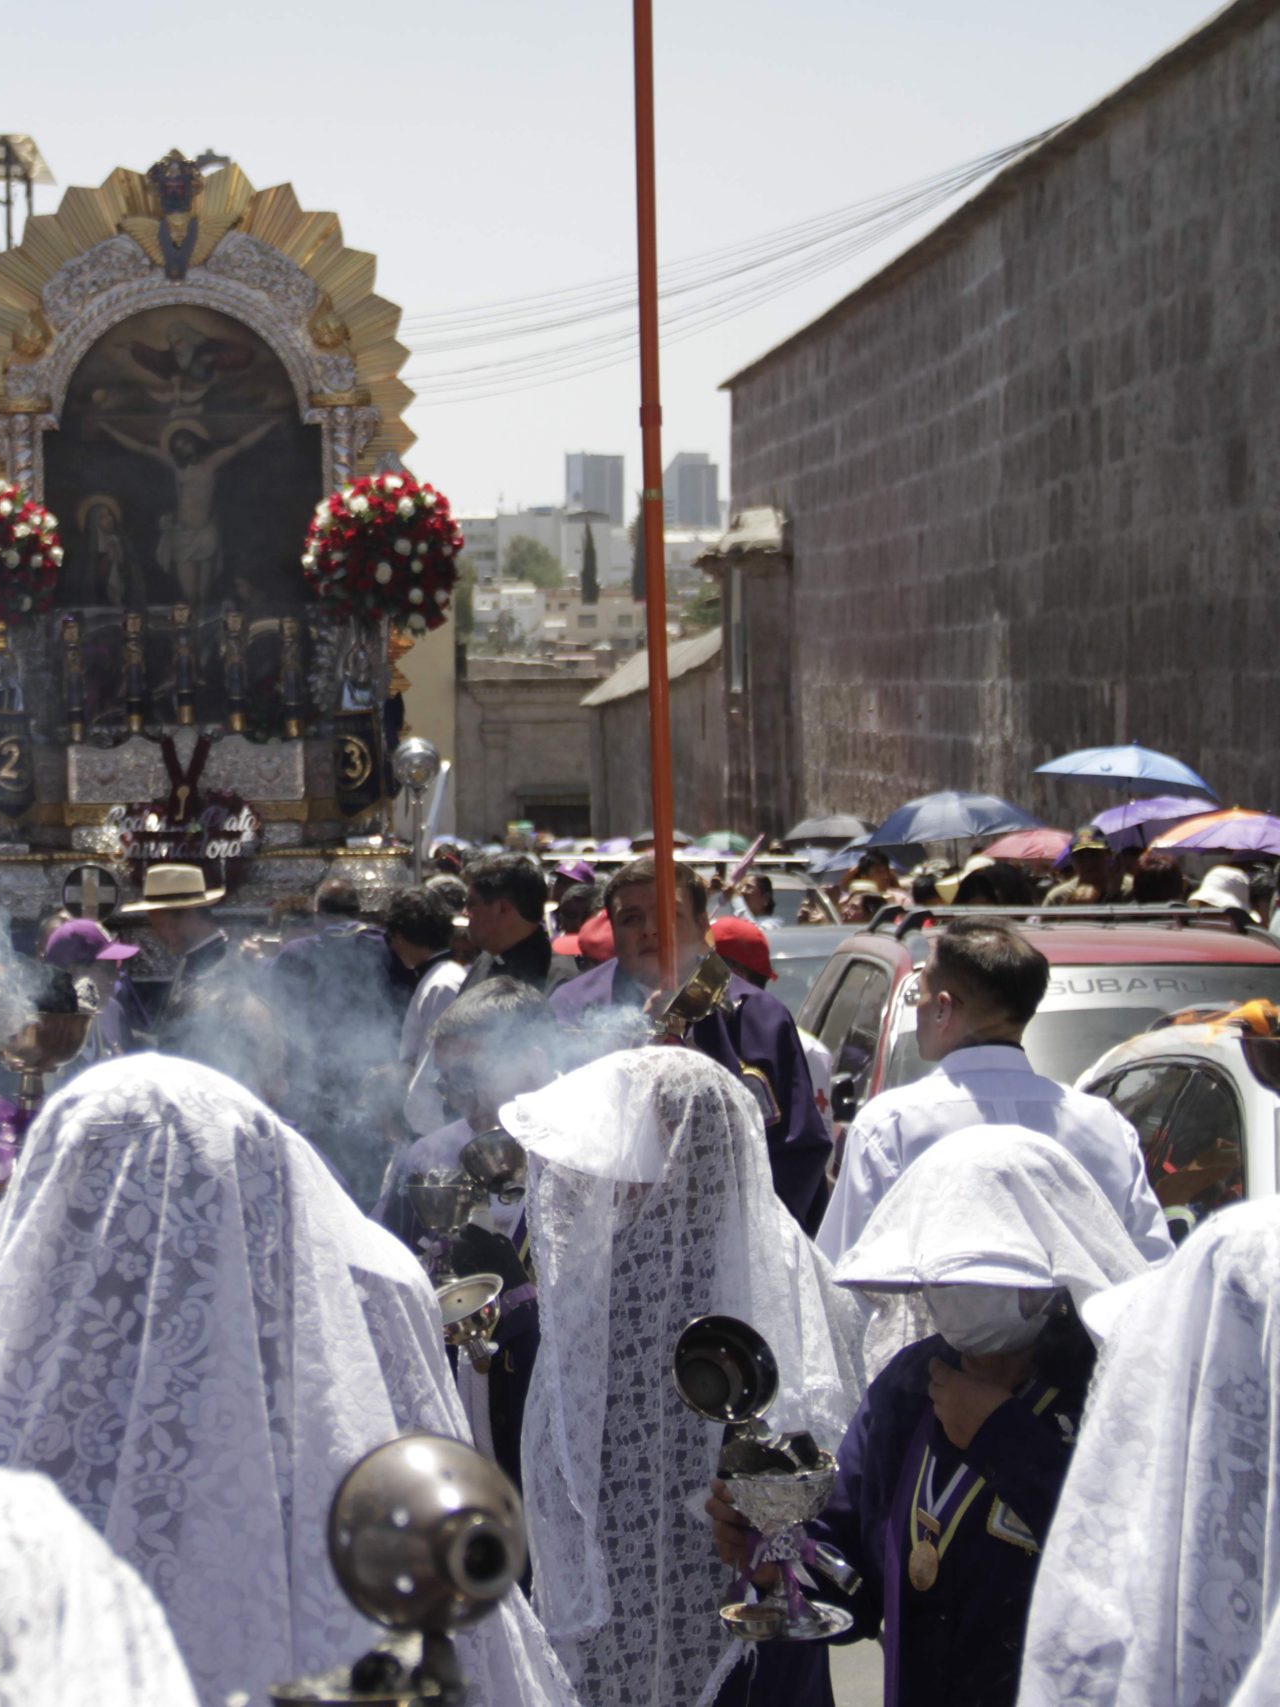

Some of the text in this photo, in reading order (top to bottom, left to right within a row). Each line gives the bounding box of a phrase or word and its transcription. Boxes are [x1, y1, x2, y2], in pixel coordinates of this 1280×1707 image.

[0, 743, 20, 779] 2
[344, 743, 363, 779] 3
[1048, 977, 1208, 996] SUBARU
